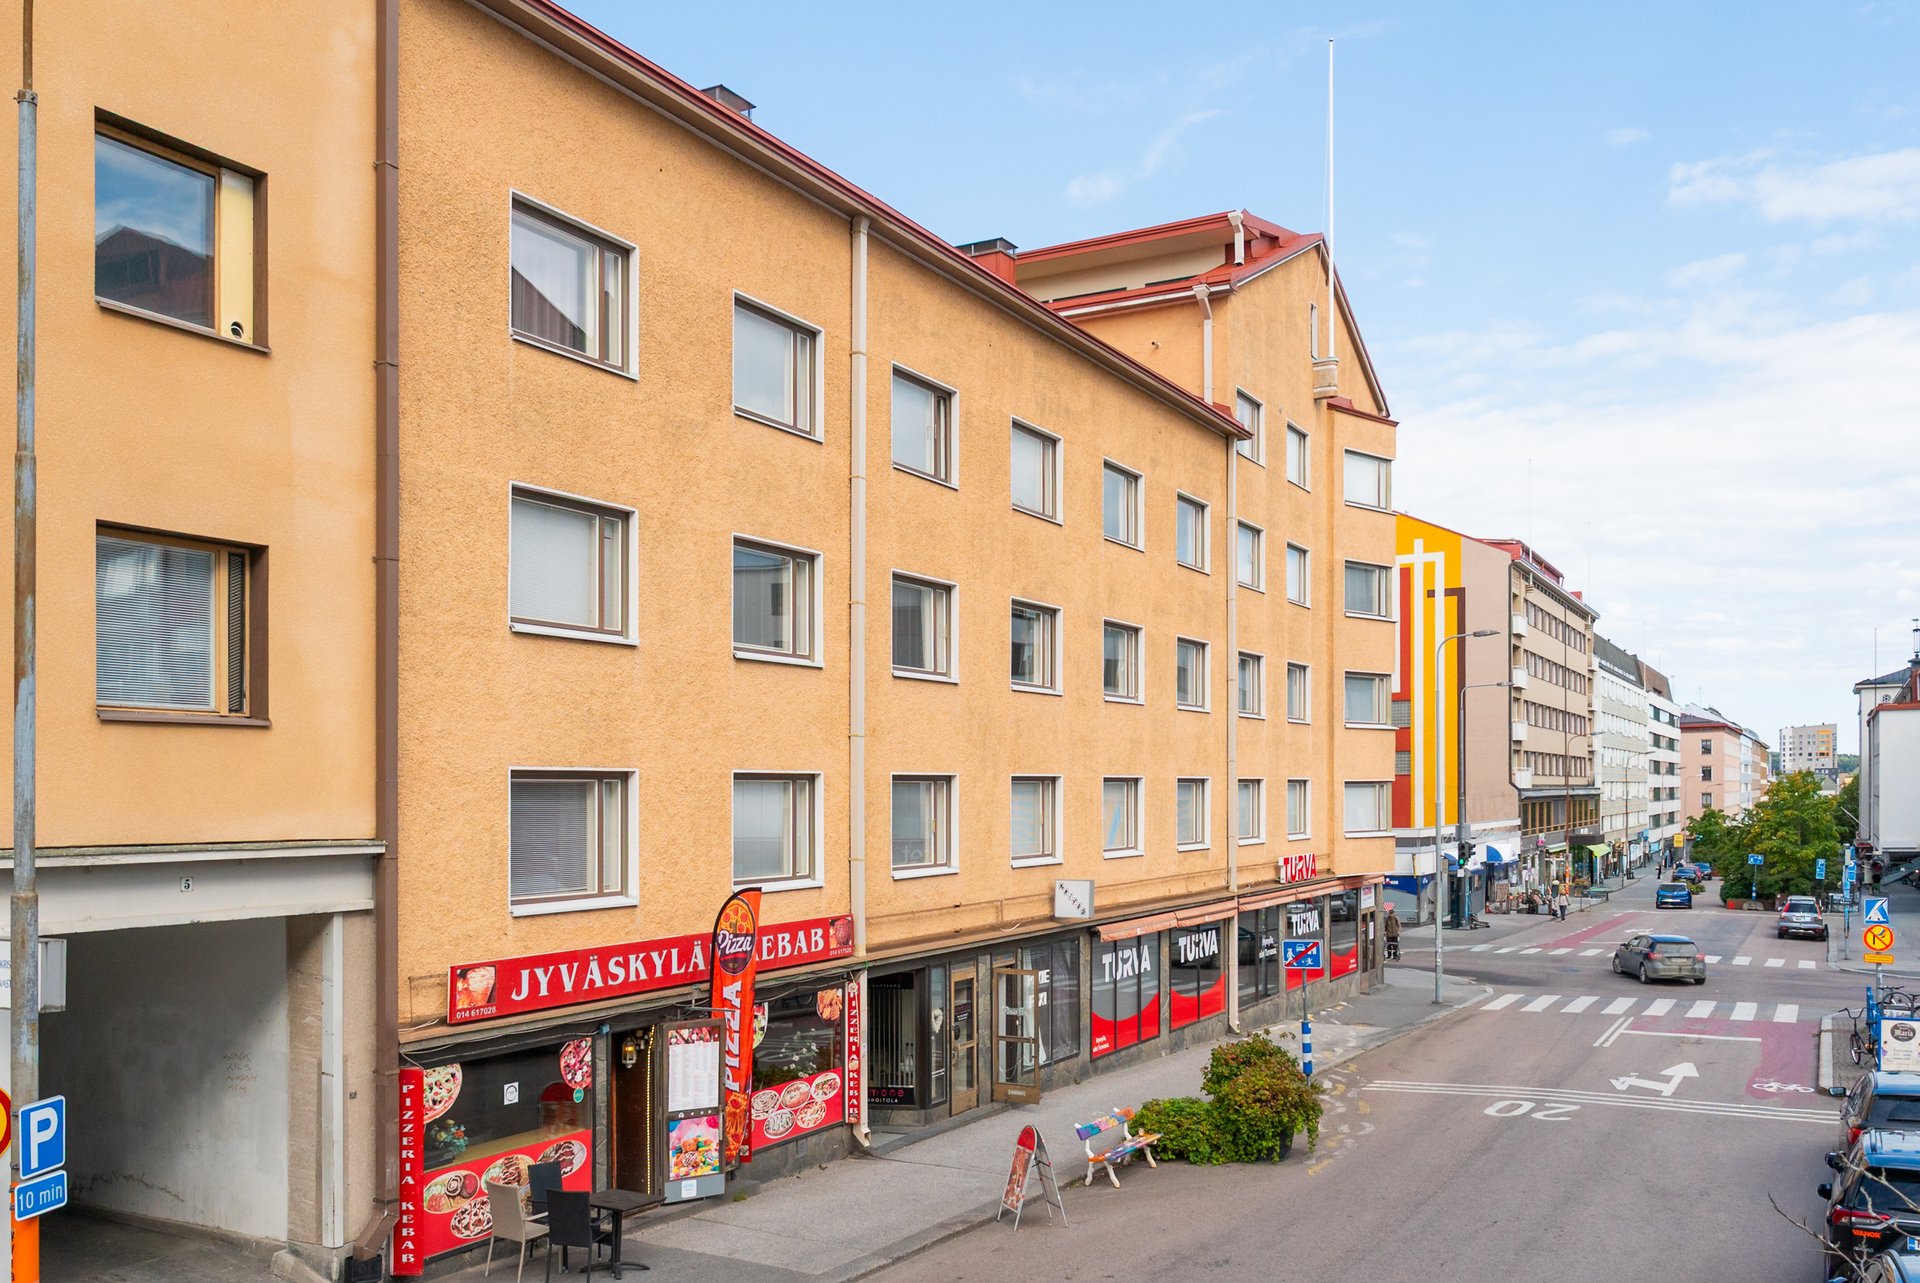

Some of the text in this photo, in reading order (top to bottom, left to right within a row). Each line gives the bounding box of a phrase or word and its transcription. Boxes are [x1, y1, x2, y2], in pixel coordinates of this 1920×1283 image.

[184, 878, 190, 890] 5
[1283, 853, 1317, 884] TURVA
[1291, 909, 1320, 937] TURVA
[717, 929, 753, 955] Pizza
[1178, 929, 1219, 964] TURVA
[510, 927, 825, 1001] JYVÄSKYLÄ EBAB
[1102, 944, 1152, 983] TURVA
[456, 1006, 497, 1019] 014 617028
[722, 980, 743, 1093] PIZZA
[869, 1089, 904, 1097] mone
[29, 1106, 59, 1170] P
[401, 1084, 416, 1264] PIZZERIA KEBAB
[18, 1184, 63, 1212] 10 min
